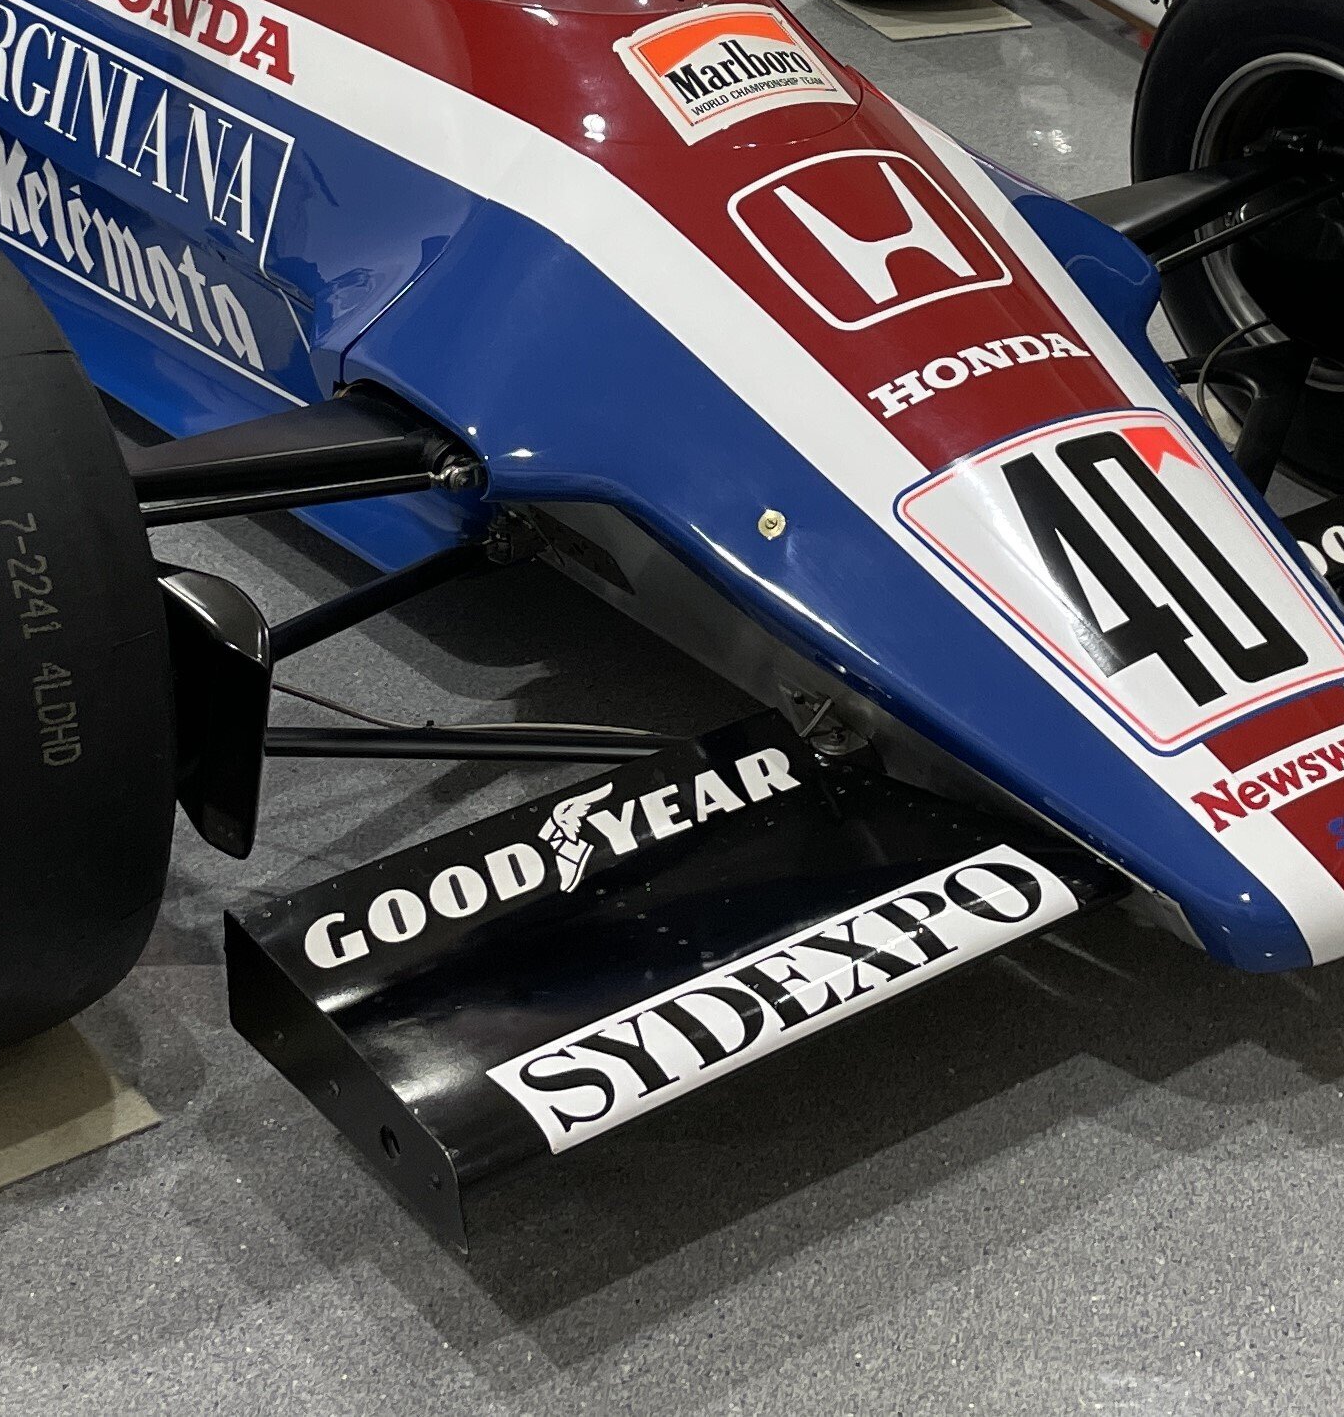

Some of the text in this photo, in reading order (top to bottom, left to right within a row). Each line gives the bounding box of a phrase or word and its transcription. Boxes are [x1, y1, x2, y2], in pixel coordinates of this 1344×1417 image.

[665, 39, 813, 105] Marlboro
[691, 76, 825, 116] WORLD CHAMPIONSHIP TEAM
[867, 330, 1089, 419] HONDA
[1000, 430, 1310, 708] 40
[304, 747, 801, 969] GOODYEAR
[519, 861, 1044, 1133] SYDEXPO
